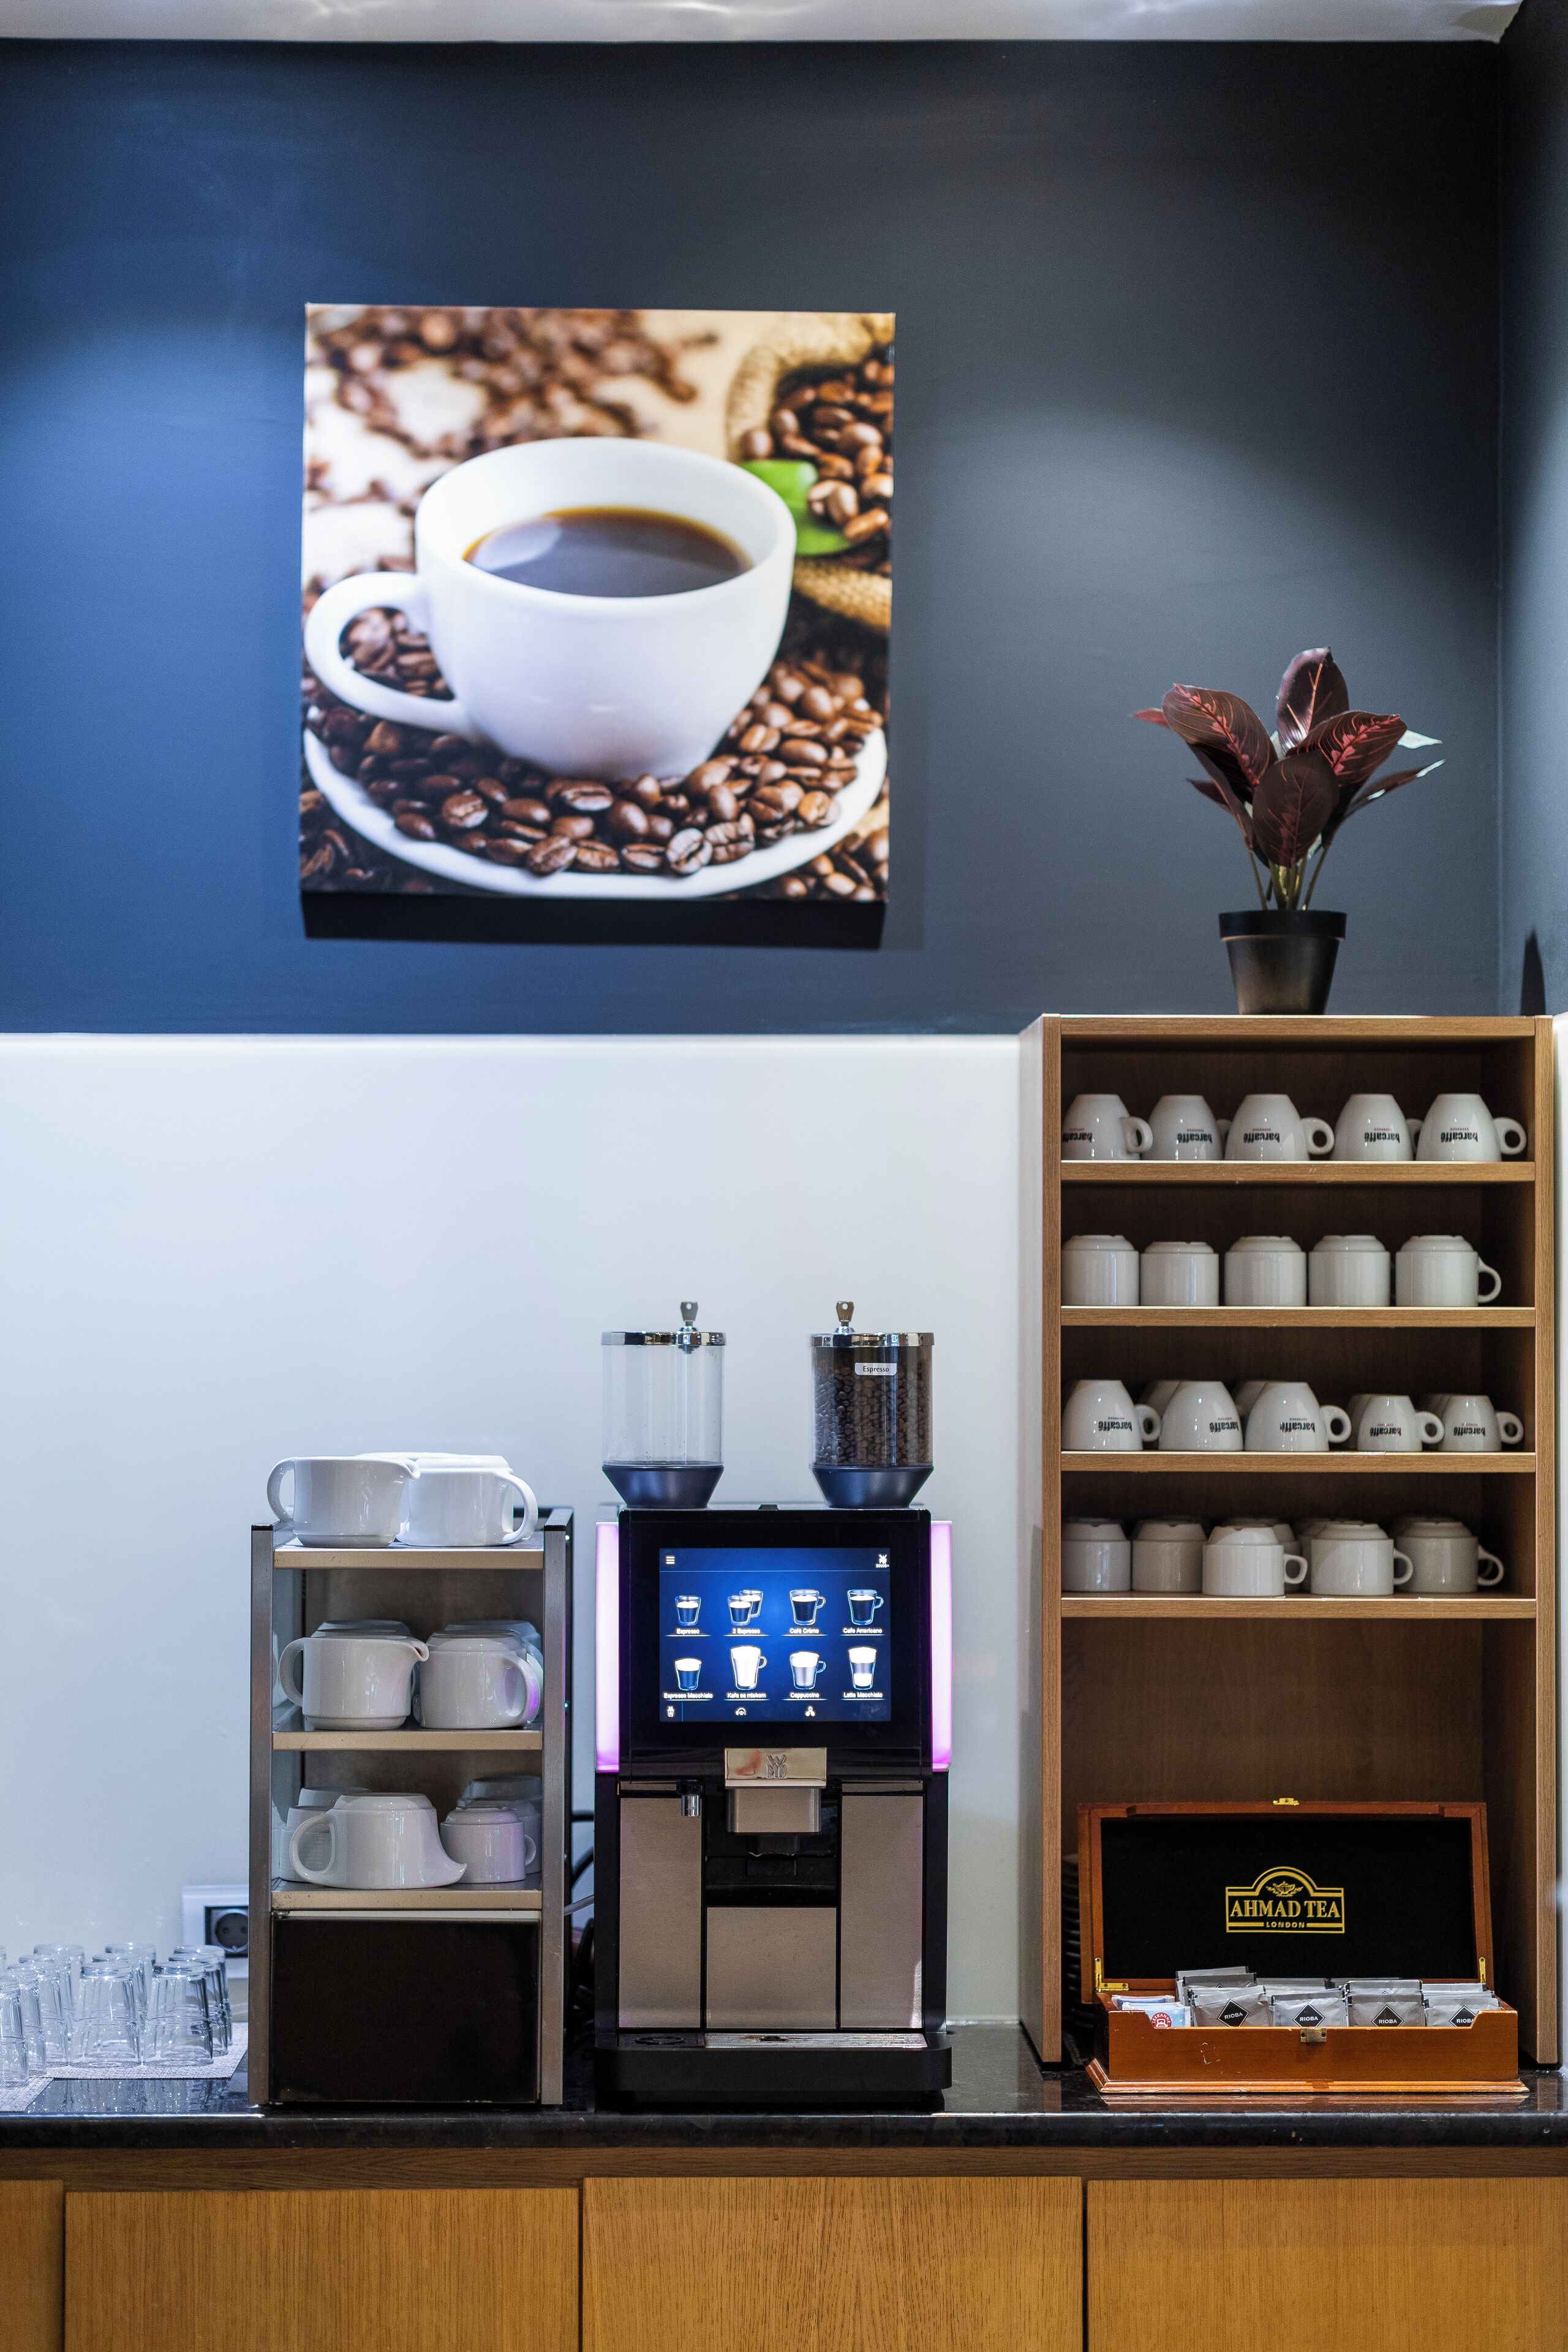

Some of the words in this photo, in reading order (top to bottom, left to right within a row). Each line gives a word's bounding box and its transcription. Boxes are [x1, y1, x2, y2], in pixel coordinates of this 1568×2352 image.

[1230, 1900, 1301, 1917] AHMAD
[1304, 1901, 1341, 1918] TEA
[1152, 2013, 1171, 2024] TEEKANNE
[1224, 2011, 1243, 2020] RIOBA
